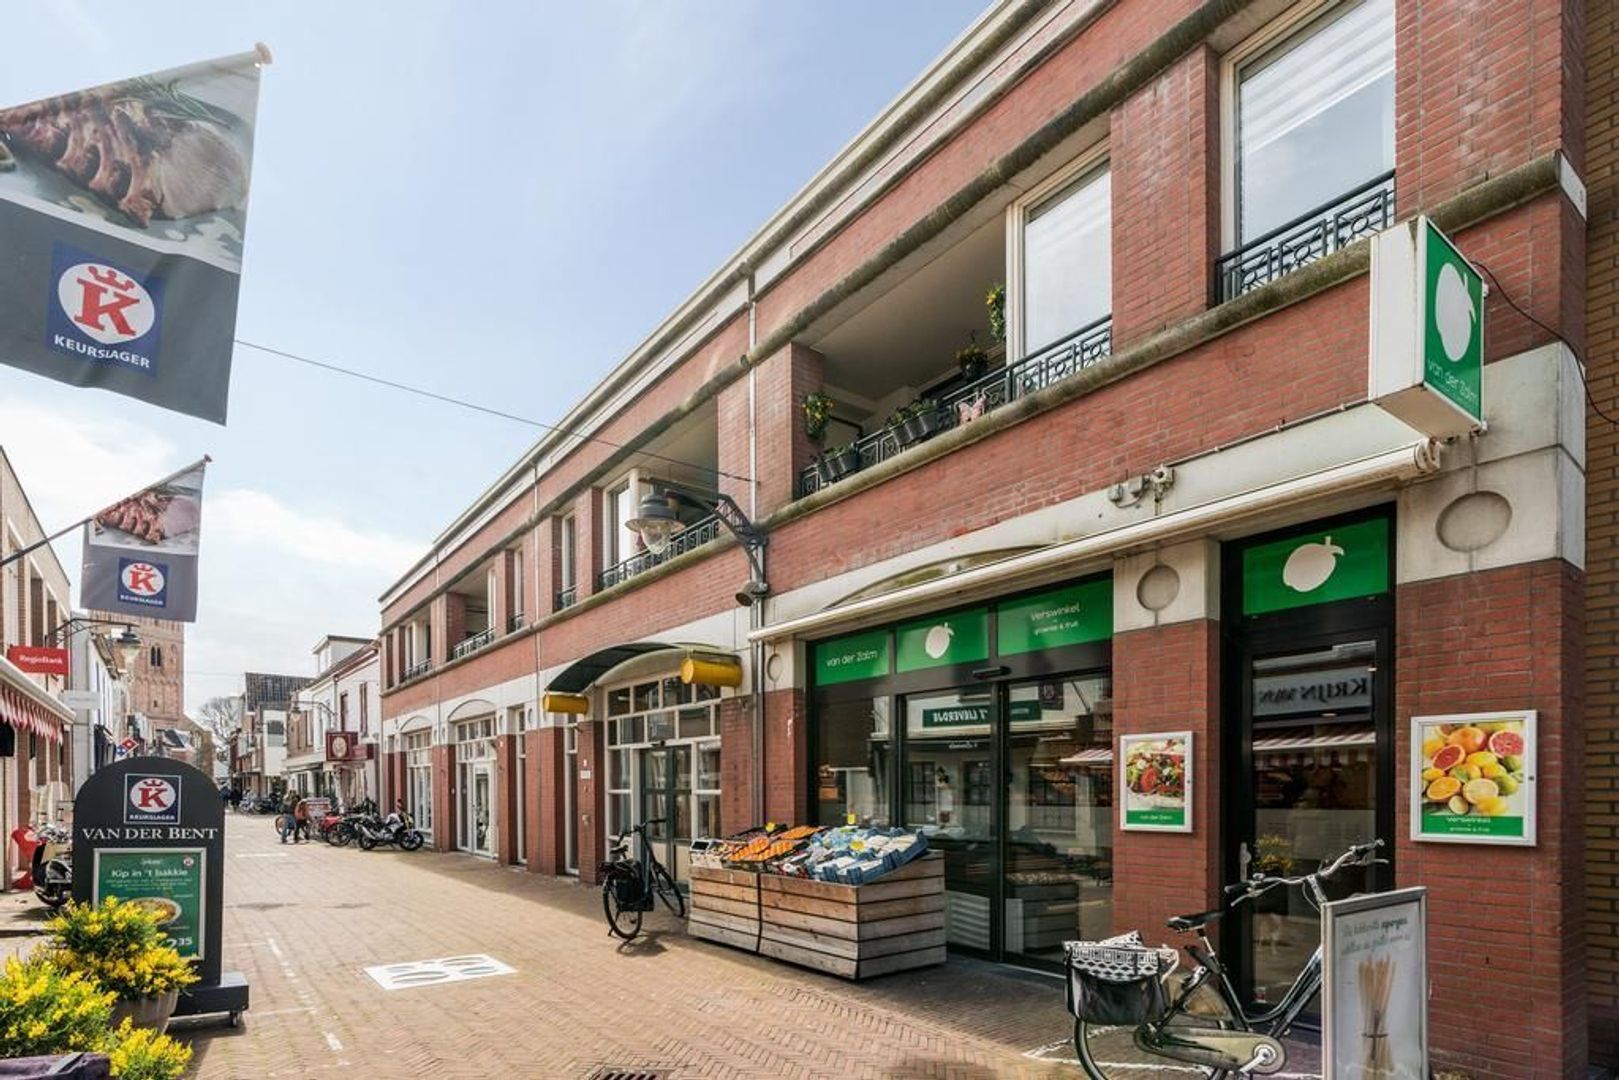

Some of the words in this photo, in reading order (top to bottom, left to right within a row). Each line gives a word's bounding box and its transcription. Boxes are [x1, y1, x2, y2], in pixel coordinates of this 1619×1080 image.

[54, 334, 151, 369] KEURSLAGER
[826, 656, 841, 668] van
[842, 651, 856, 665] der
[82, 828, 123, 840] VAN
[124, 827, 163, 841] DER
[168, 827, 218, 841] BENT
[111, 868, 129, 879] Kip
[131, 868, 142, 877] in
[155, 867, 189, 877] bakkie
